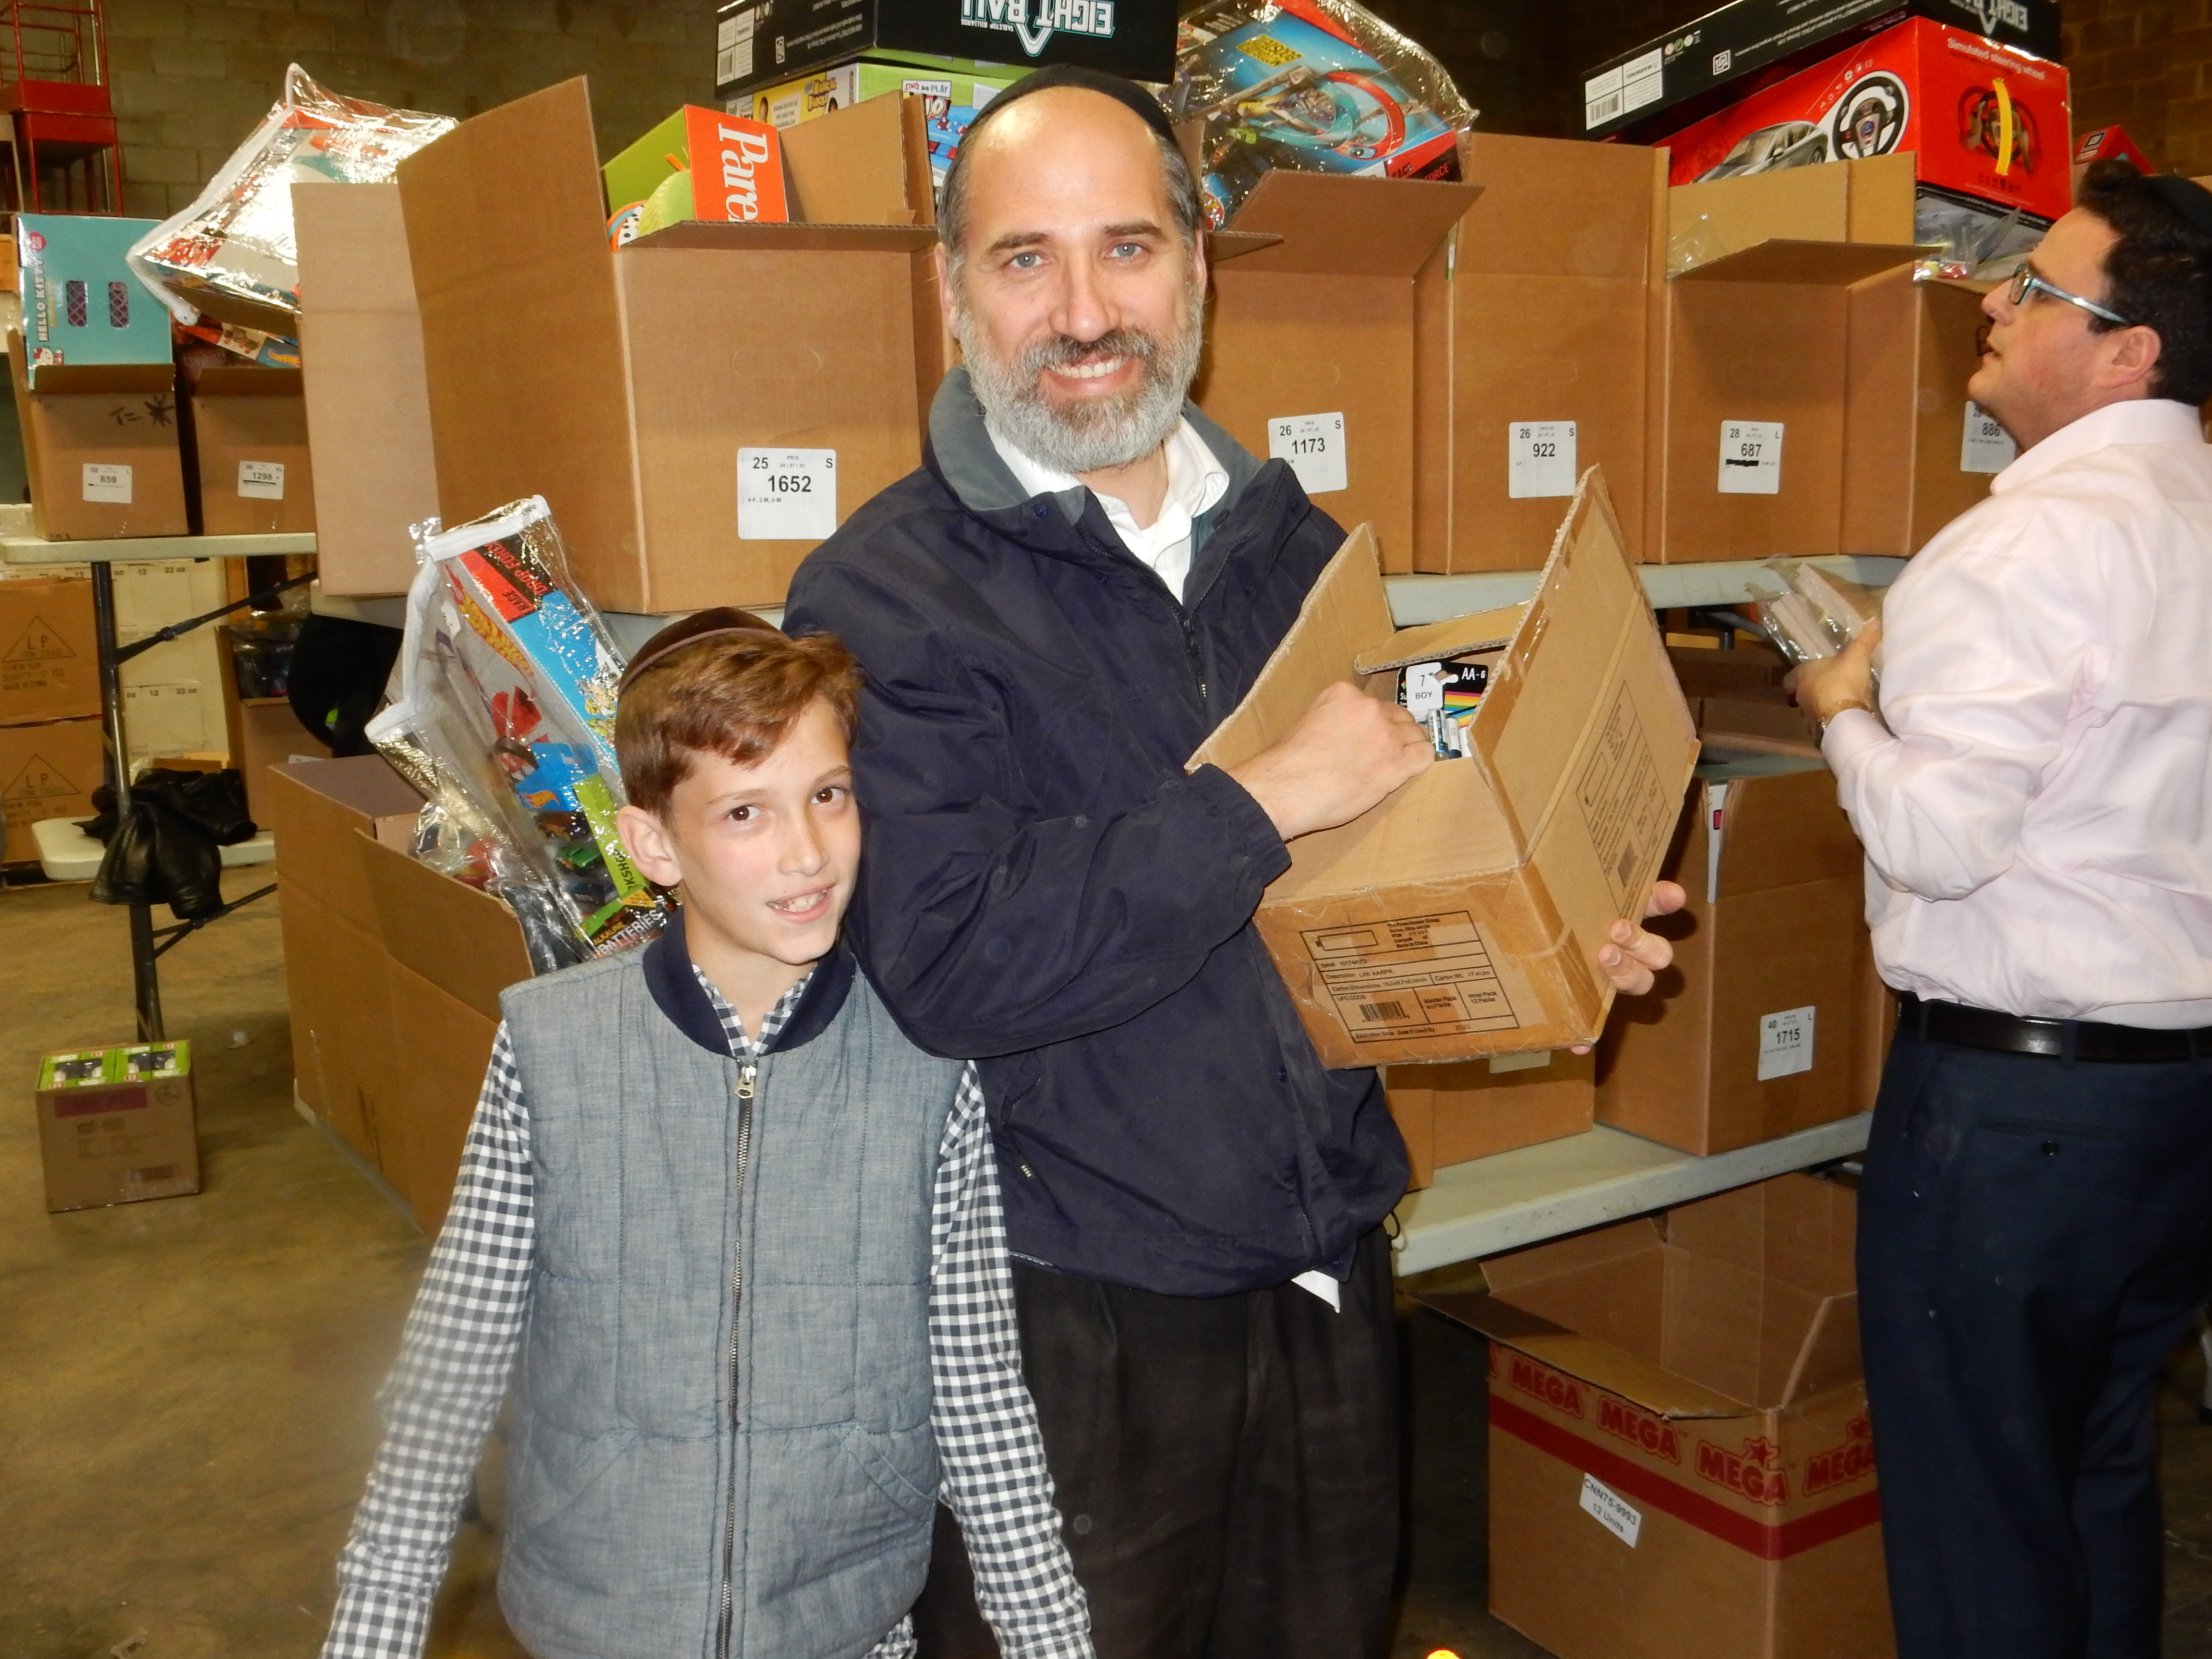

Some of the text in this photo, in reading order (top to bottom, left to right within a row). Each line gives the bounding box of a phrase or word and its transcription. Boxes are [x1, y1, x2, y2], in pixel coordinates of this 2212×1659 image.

[1034, 0, 1115, 36] EIGHT
[1988, 0, 2029, 33] EIGHT
[961, 19, 1014, 32] TABLETOP BILLIARDS
[1948, 37, 2045, 80] Simulated steering wheel
[931, 85, 949, 93] PLAY
[718, 123, 769, 222] Pare
[1424, 162, 1449, 180] FORCE
[33, 259, 47, 299] KITTY
[35, 301, 49, 342] HELLO
[1280, 425, 1291, 436] 26
[1335, 420, 1341, 429] S
[1520, 429, 1530, 439] 26
[1569, 428, 1574, 436] S
[1730, 428, 1780, 439] 28 L
[1292, 438, 1325, 455] 1173
[1533, 443, 1555, 457] 922
[1741, 443, 1762, 457] 687
[753, 457, 769, 469] 25
[826, 458, 833, 468] S
[100, 475, 117, 483] 859
[252, 472, 273, 481] 1298
[768, 475, 811, 492] 1652
[514, 569, 549, 595] DROP
[502, 590, 529, 611] RACE
[28, 635, 48, 649] L P
[1420, 675, 1425, 687] 7
[1462, 667, 1486, 681] AA-6
[1415, 691, 1433, 699] BOY
[26, 773, 48, 788] L P
[593, 921, 626, 945] ALKALINE
[597, 910, 662, 955] BATTERIES
[1325, 971, 1356, 980] Description
[1355, 1031, 1382, 1039] Expiration
[1776, 1028, 1800, 1044] 1715
[1510, 1355, 1582, 1418] MEGA
[1598, 1396, 1680, 1463] MEGA
[1698, 1444, 1788, 1503] MEGA
[1585, 1479, 1636, 1525] CNN75-9993
[1593, 1503, 1623, 1532] 12 Units
